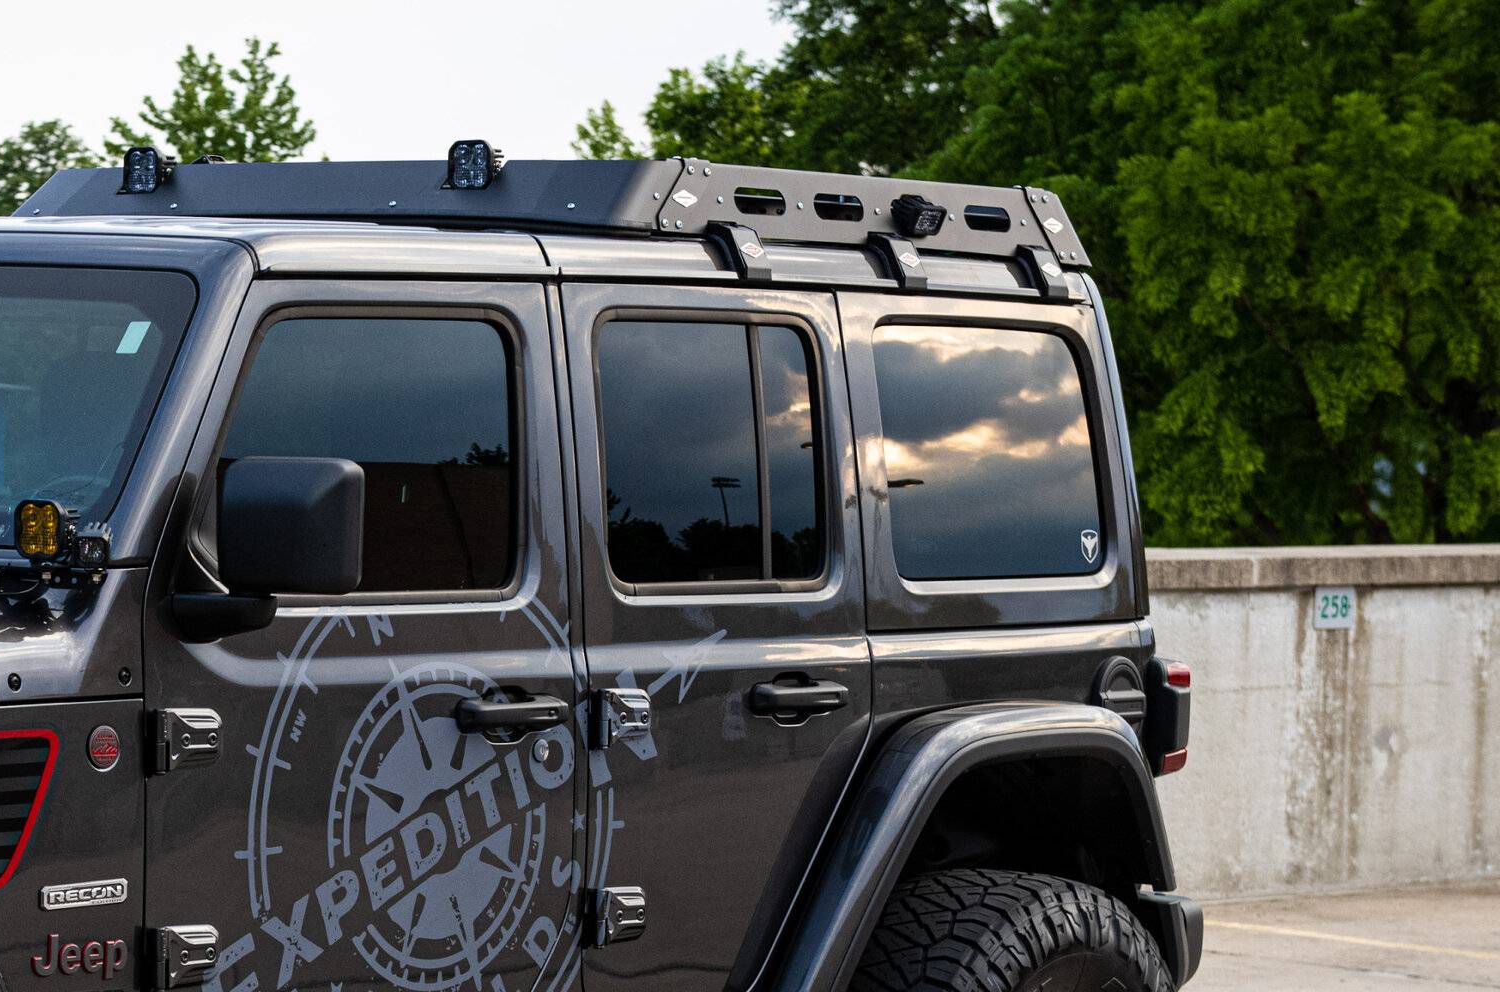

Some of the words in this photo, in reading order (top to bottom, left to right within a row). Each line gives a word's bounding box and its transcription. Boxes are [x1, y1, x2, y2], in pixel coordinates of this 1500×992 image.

[1320, 594, 1349, 618] 258
[48, 884, 122, 904] RECON
[30, 932, 128, 981] Jeep
